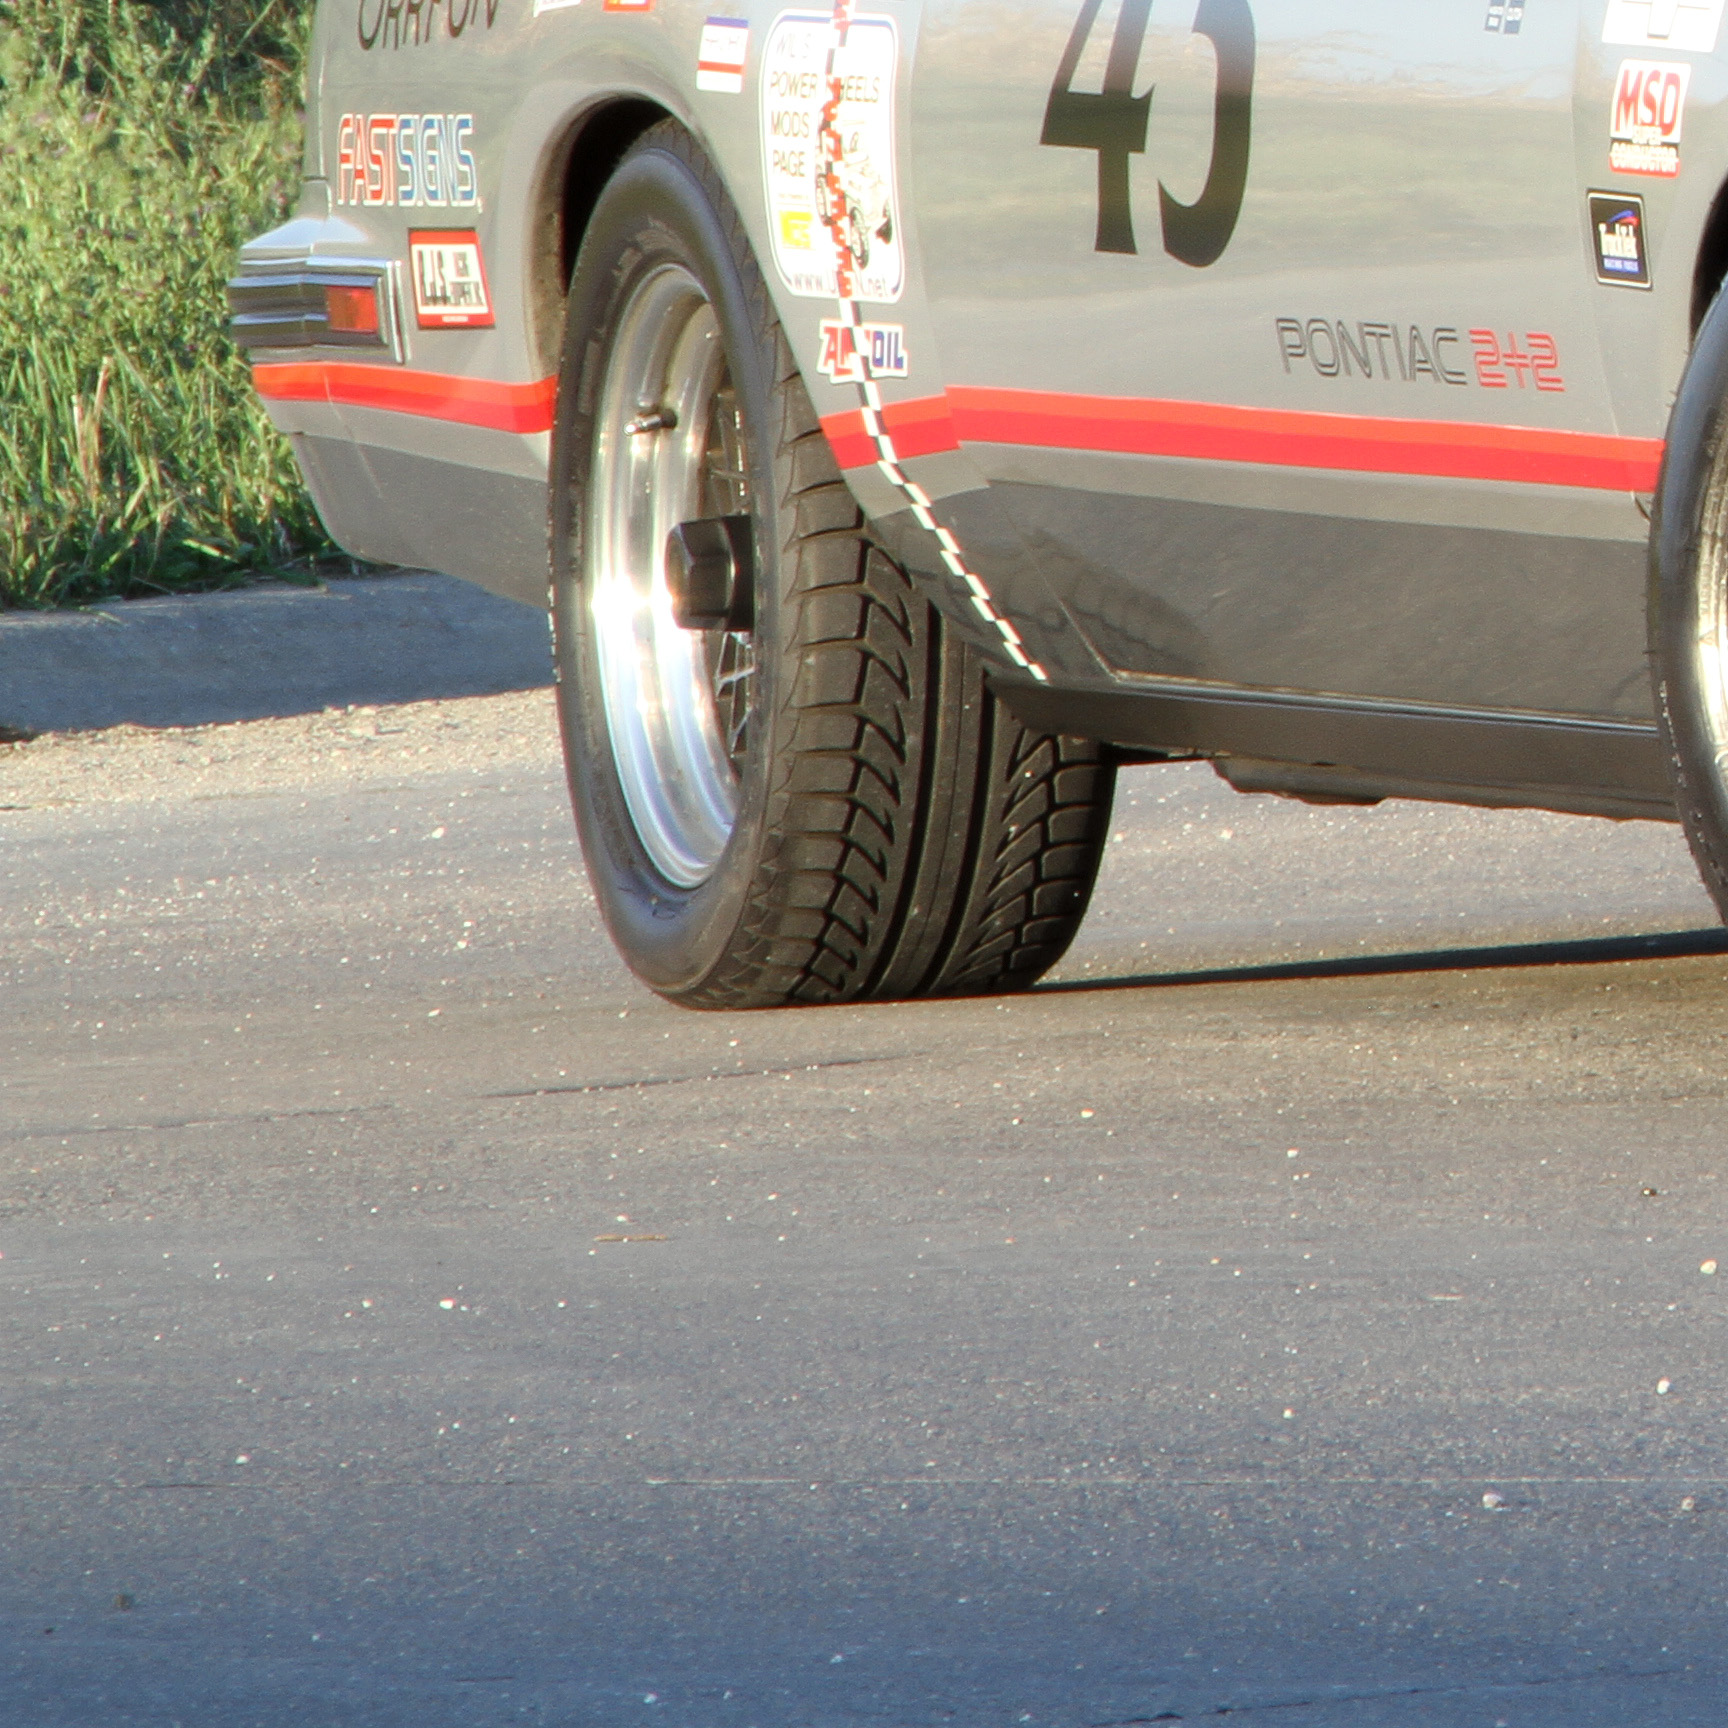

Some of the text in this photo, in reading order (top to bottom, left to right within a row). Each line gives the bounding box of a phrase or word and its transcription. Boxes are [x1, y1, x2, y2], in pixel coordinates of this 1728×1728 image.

[769, 70, 819, 100] POWER
[1614, 68, 1681, 138] MSD
[770, 109, 810, 139] MODS
[336, 113, 479, 209] FASTSIGNS
[772, 148, 806, 178] PAGE
[823, 324, 905, 376] AMOIL
[1274, 316, 1566, 393] PONTIAC 2+2
